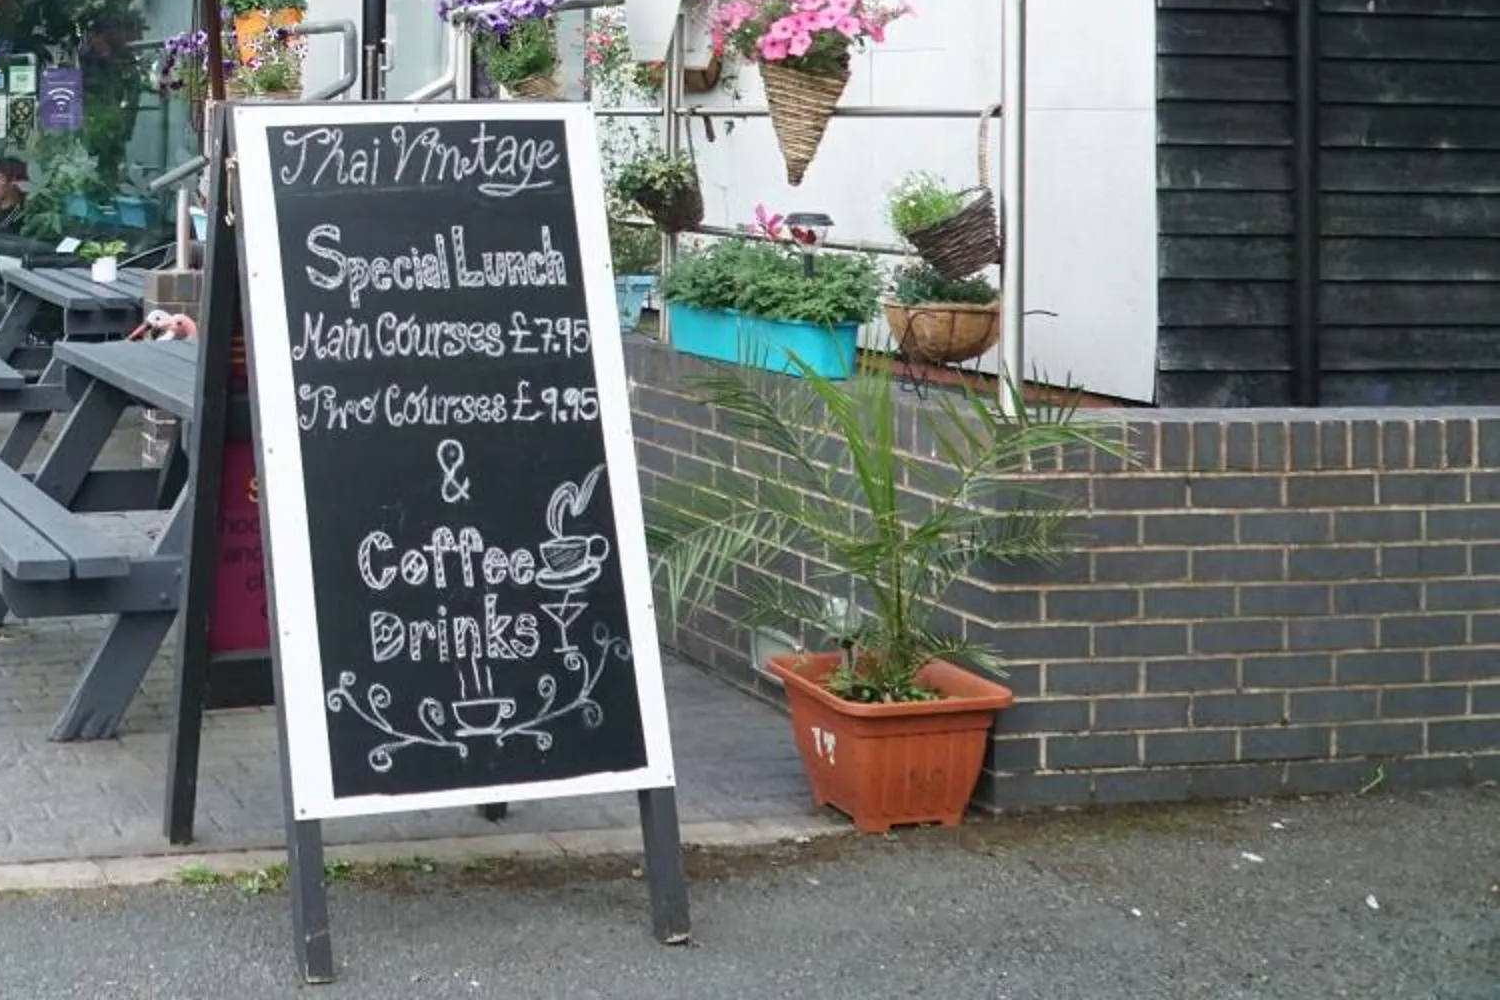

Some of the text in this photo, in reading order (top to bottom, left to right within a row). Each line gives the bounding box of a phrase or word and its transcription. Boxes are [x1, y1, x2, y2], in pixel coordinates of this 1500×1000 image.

[280, 122, 560, 197] Thai Vintage
[305, 224, 568, 308] Special Lunch
[292, 311, 591, 361] Main Courses £7.95
[298, 383, 378, 431] Two
[383, 384, 507, 426] Courses
[437, 438, 470, 503] &
[358, 527, 537, 591] Coffee
[370, 594, 541, 663] Drinks
